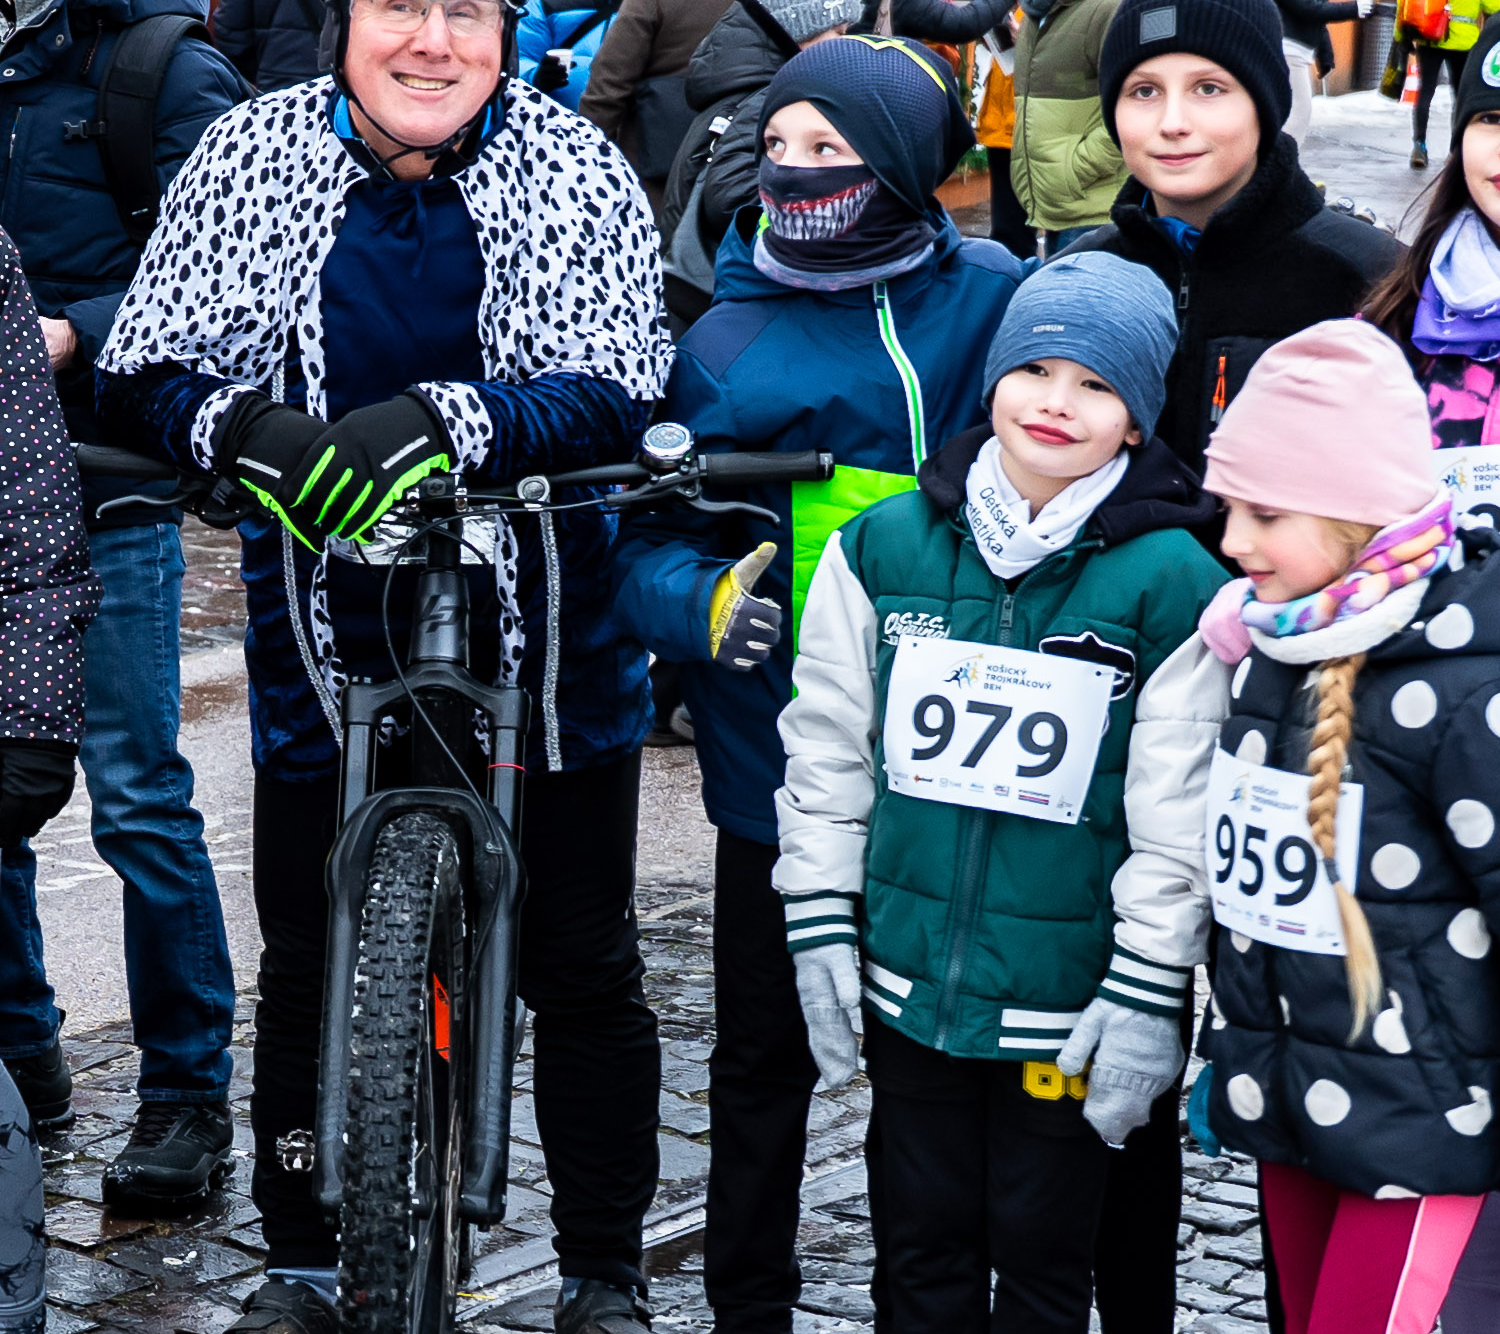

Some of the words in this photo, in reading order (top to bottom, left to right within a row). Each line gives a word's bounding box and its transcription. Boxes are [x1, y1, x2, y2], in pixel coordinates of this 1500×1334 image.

[1474, 484, 1492, 492] BEH
[979, 487, 1019, 540] Detská
[983, 682, 1002, 691] BEH
[986, 664, 1027, 677] KOŠICKÝ
[911, 693, 1068, 778] 979
[1215, 813, 1318, 907] 959
